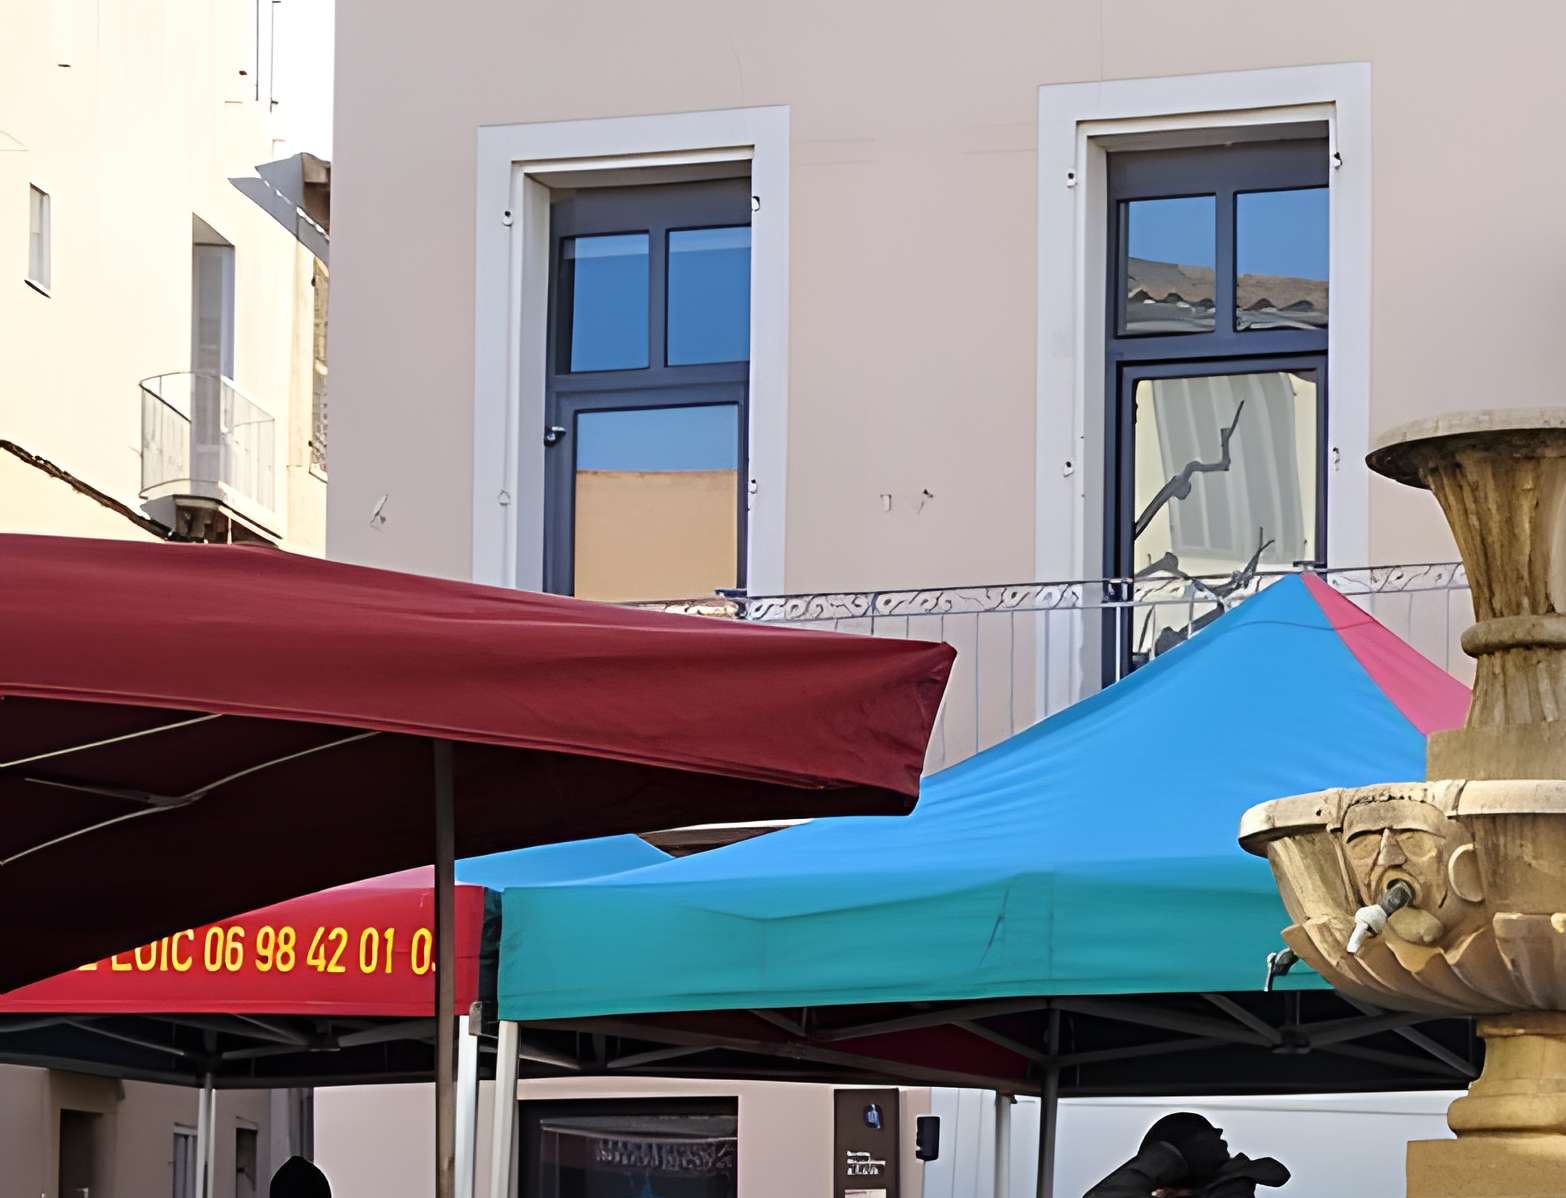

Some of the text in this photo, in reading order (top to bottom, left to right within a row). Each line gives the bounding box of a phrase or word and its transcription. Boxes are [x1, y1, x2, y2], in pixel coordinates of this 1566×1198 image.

[204, 925, 245, 972] 06
[255, 924, 296, 973] 98
[306, 926, 348, 973] 42
[359, 926, 395, 974] 01
[411, 927, 436, 975] 0
